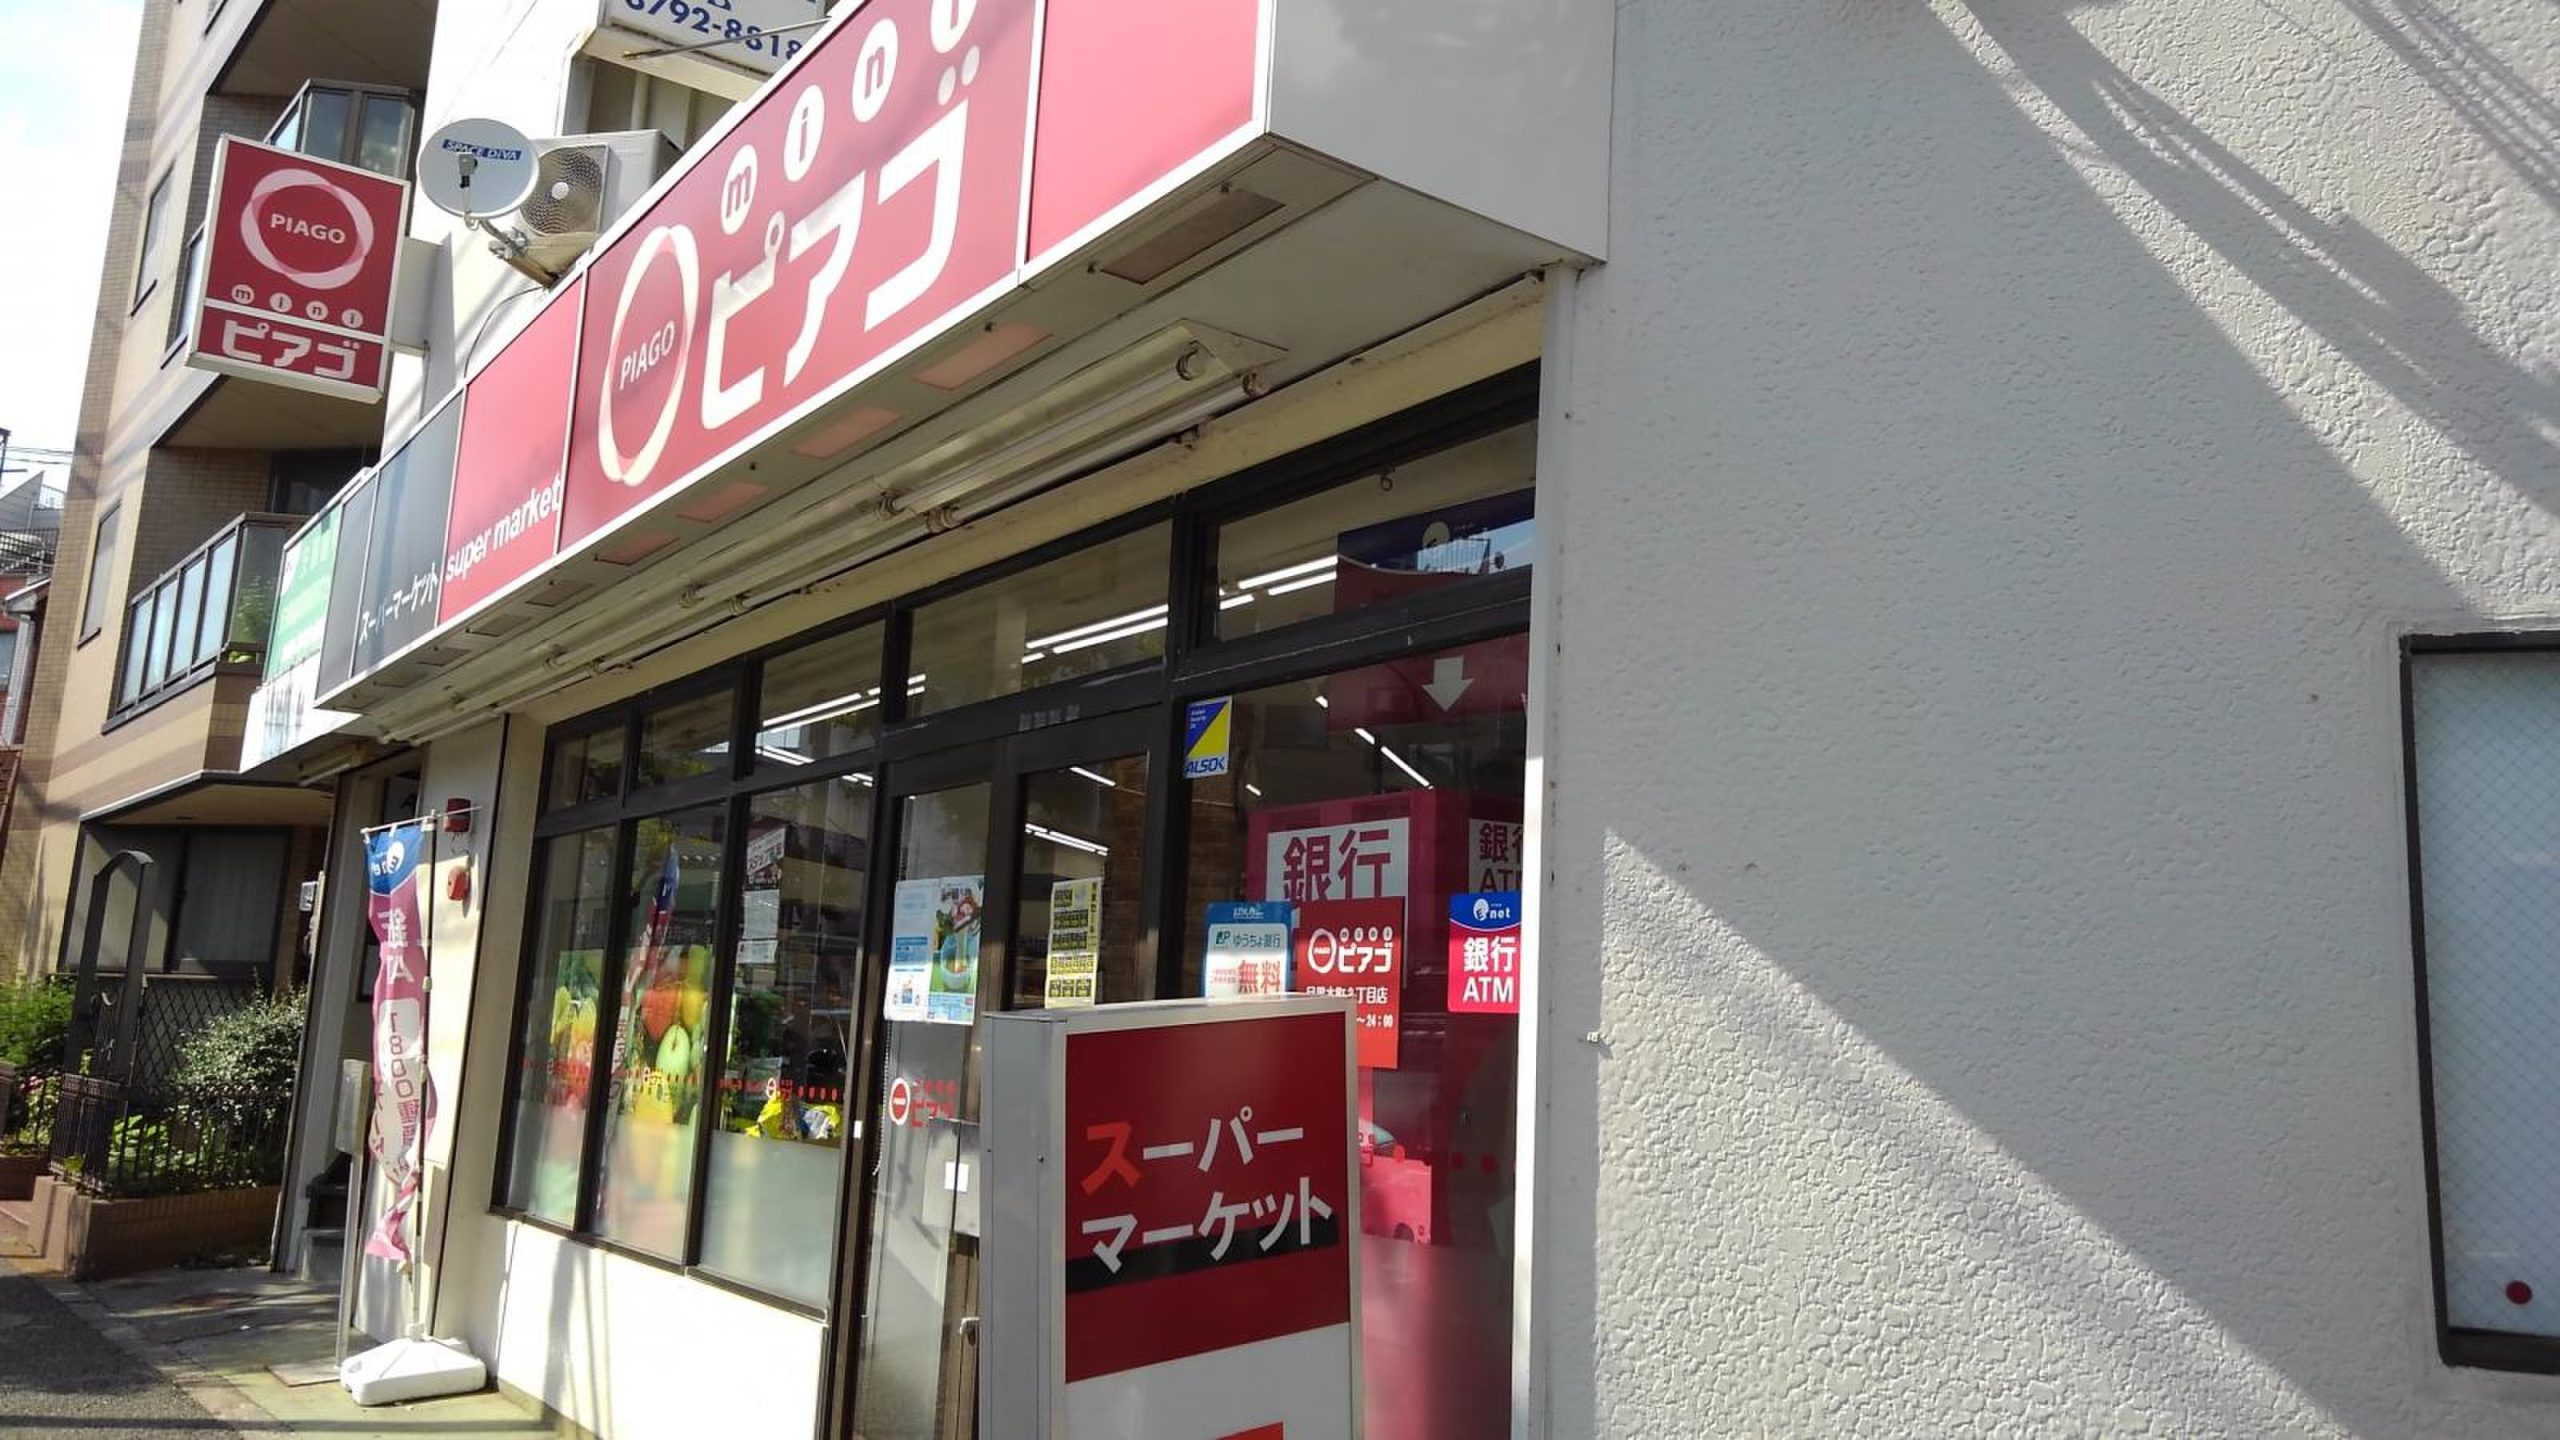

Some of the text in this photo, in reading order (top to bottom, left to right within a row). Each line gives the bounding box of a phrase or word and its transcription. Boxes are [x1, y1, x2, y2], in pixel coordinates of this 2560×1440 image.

[269, 213, 347, 245] PIAGO
[701, 44, 981, 430] ピアゴ
[235, 287, 355, 325] mini
[221, 319, 362, 380] ピアゴ
[619, 320, 675, 392] PIAGO
[445, 473, 562, 583] super market
[1187, 756, 1225, 774] ALSOK
[1283, 829, 1391, 901] 銀行
[1479, 867, 1522, 892] AT
[1338, 942, 1393, 973] ピアゴ
[1463, 936, 1516, 973] 銀行
[1237, 960, 1281, 994] 無料
[1462, 976, 1514, 1004] ATM
[1081, 1105, 1304, 1196] スーパー
[1081, 1176, 1333, 1274] マーケット
